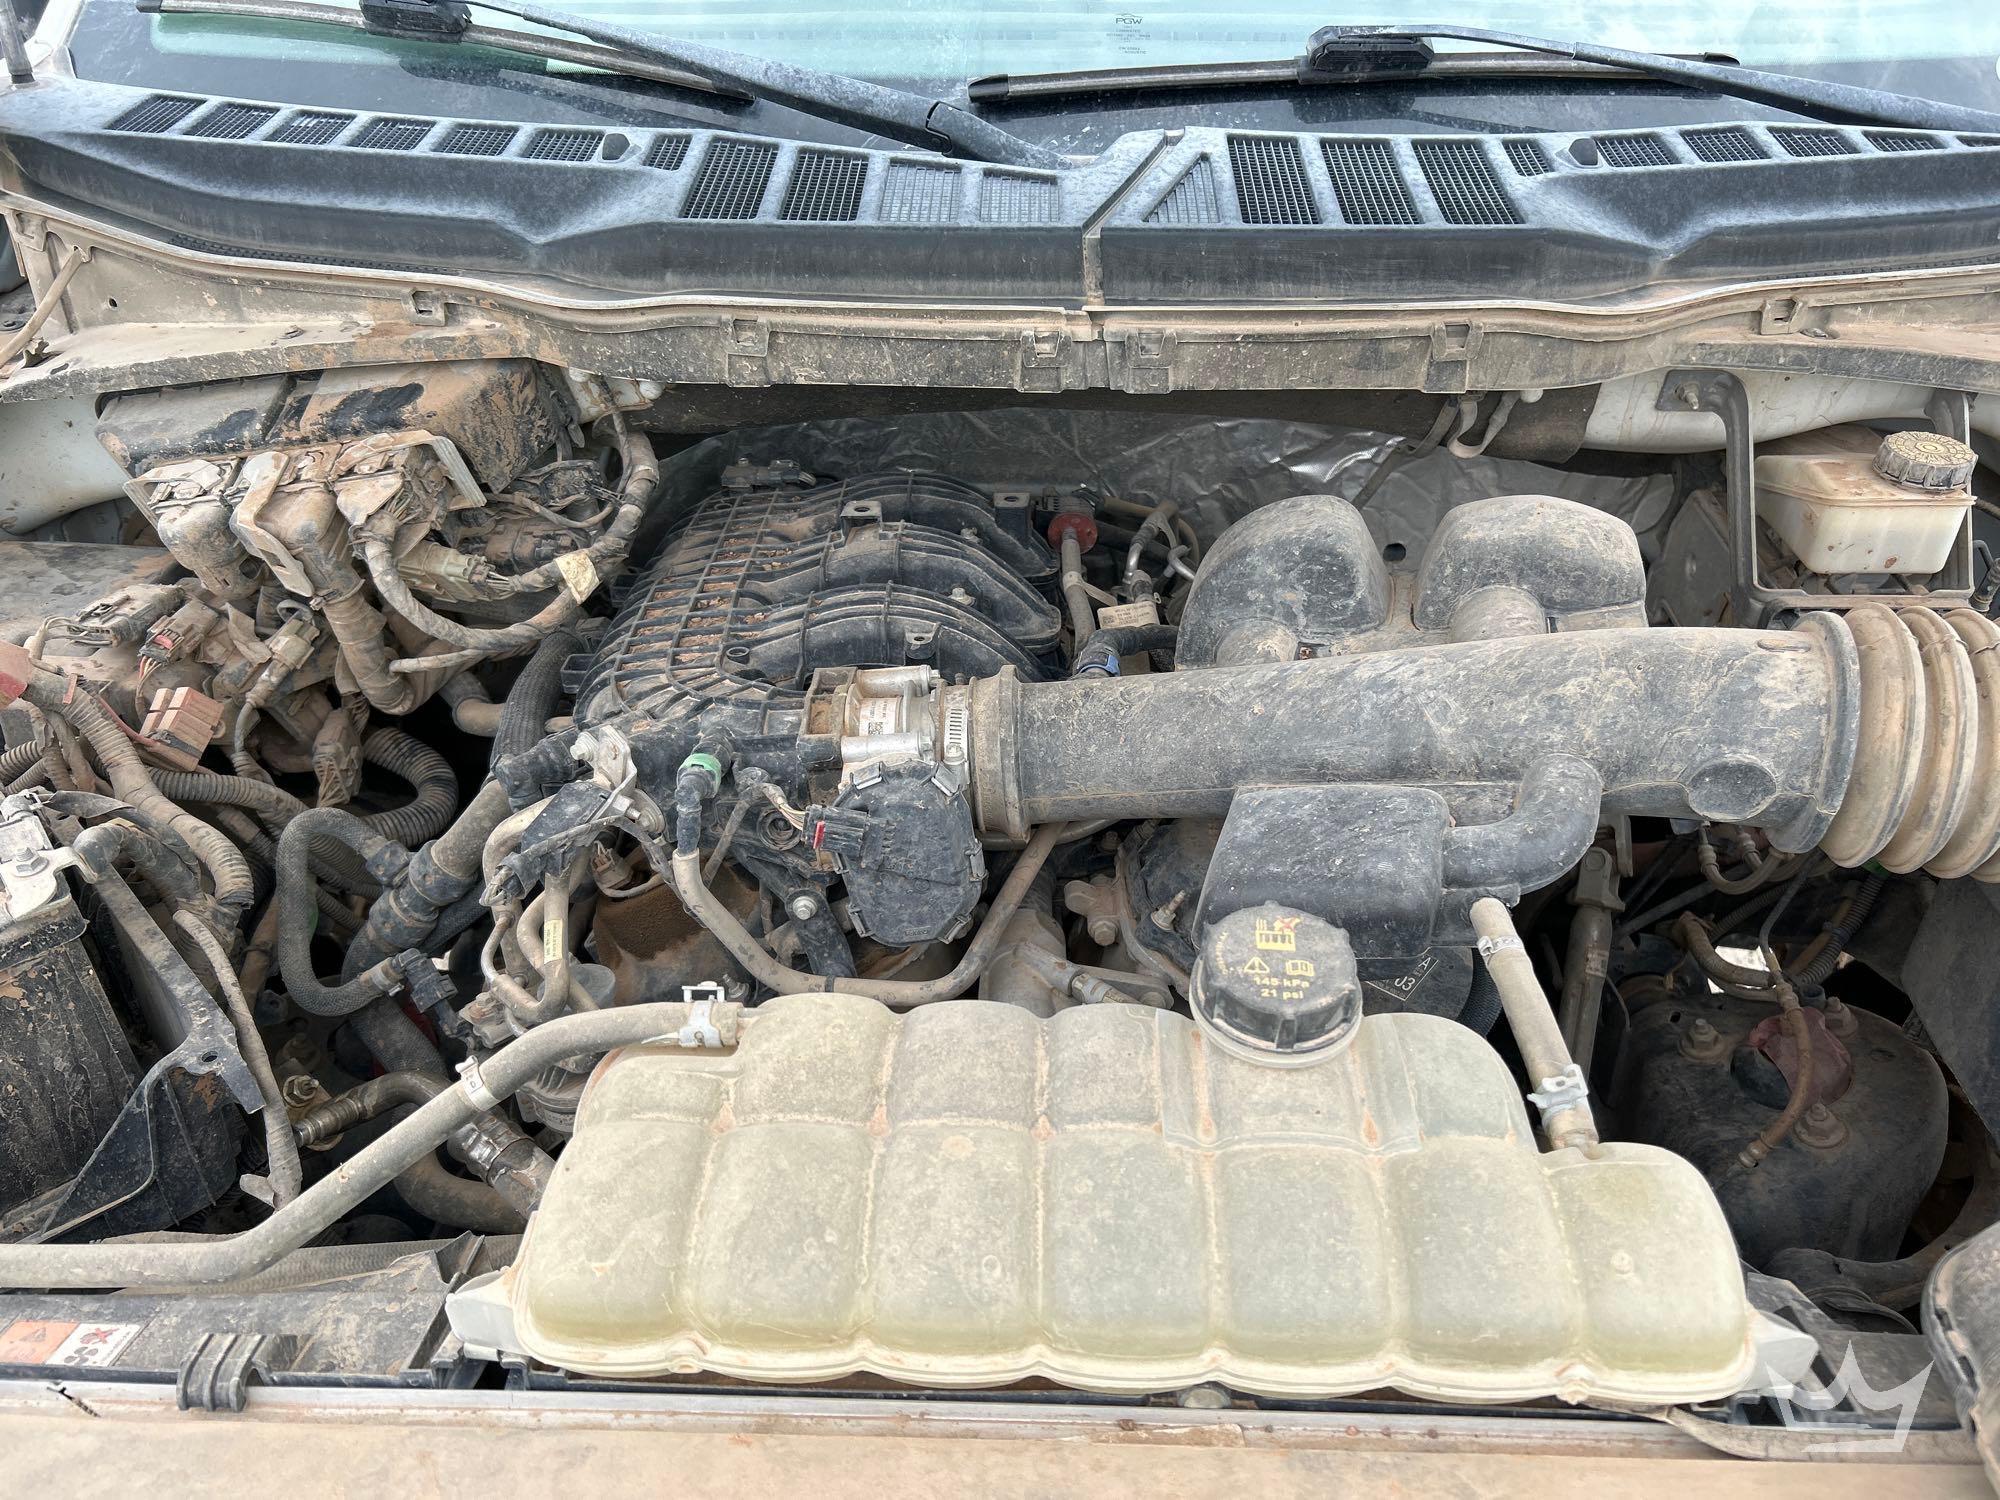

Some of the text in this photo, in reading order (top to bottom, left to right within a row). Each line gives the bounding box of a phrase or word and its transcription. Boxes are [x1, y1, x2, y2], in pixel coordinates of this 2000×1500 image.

[1254, 976, 1310, 988] 145 kPa
[1261, 988, 1304, 1000] 21 psi
